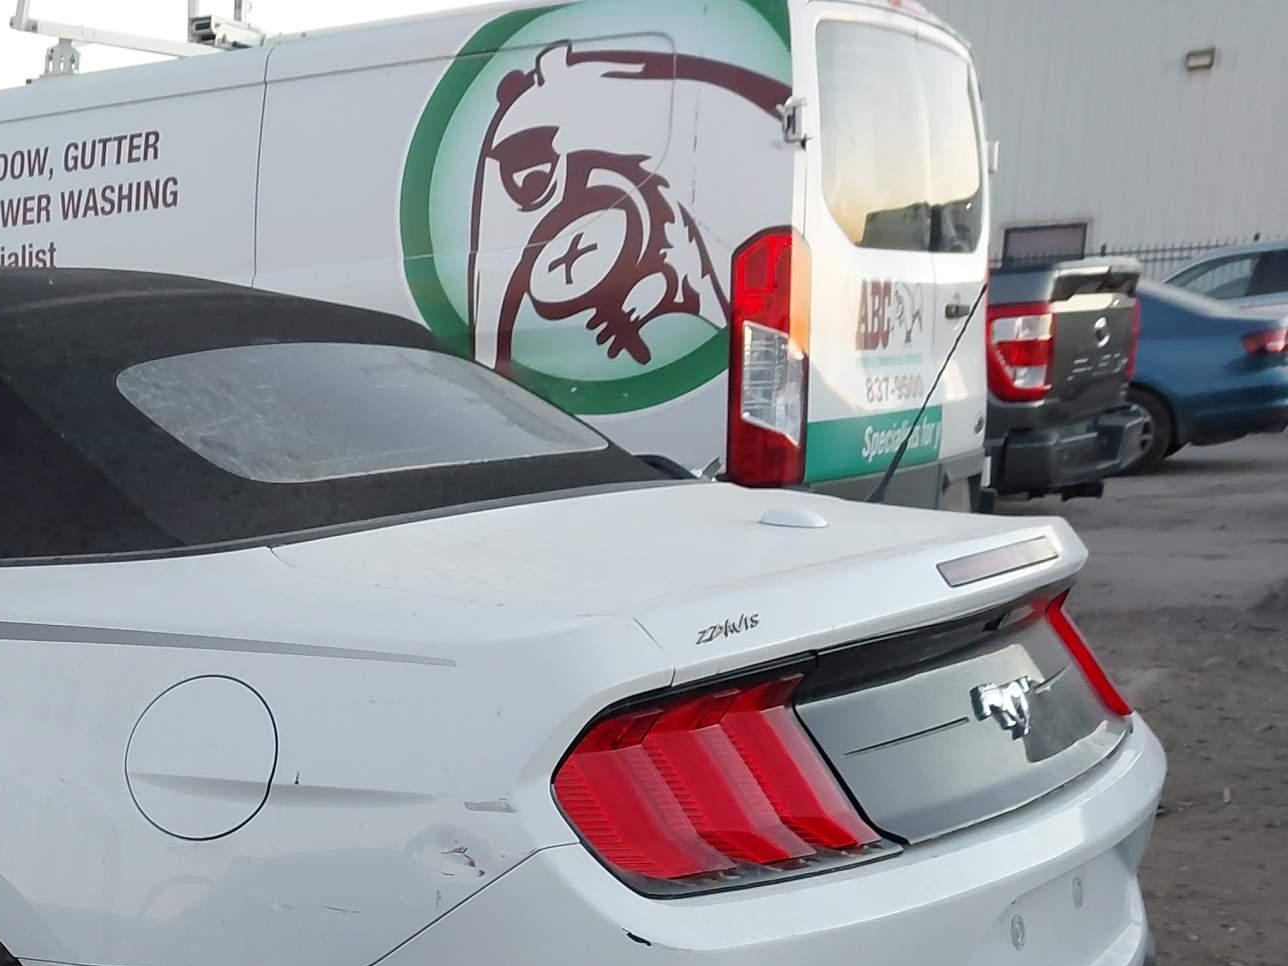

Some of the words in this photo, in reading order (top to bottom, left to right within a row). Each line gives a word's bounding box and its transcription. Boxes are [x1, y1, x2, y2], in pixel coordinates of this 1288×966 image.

[63, 130, 160, 172] GUTTER
[60, 177, 179, 220] WASHING
[855, 279, 891, 350] ABC
